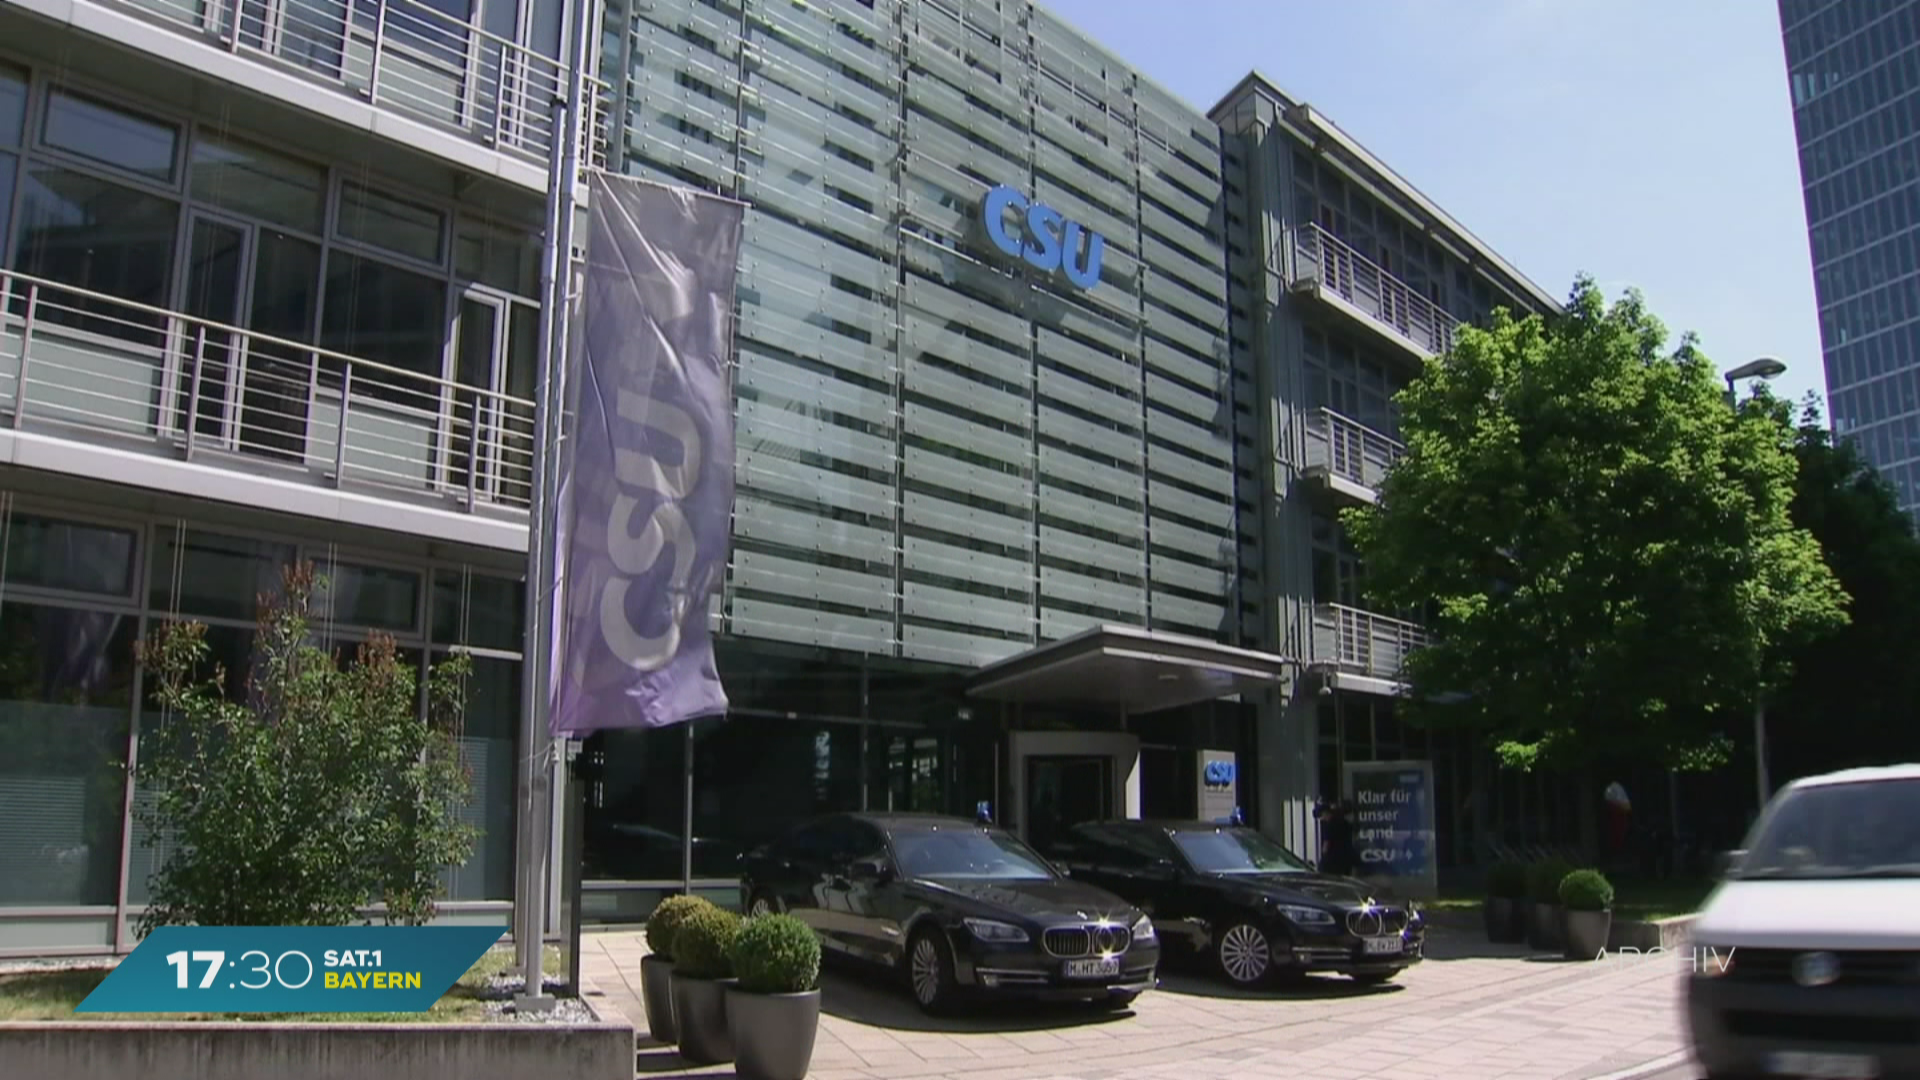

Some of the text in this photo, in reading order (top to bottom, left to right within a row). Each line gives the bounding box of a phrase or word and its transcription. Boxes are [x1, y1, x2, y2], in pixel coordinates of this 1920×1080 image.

[981, 185, 1105, 290] CSU
[601, 387, 700, 672] CSU
[1205, 760, 1236, 784] CSU
[1358, 788, 1411, 804] Klar für
[1359, 809, 1398, 822] unser
[1360, 848, 1395, 863] CSU
